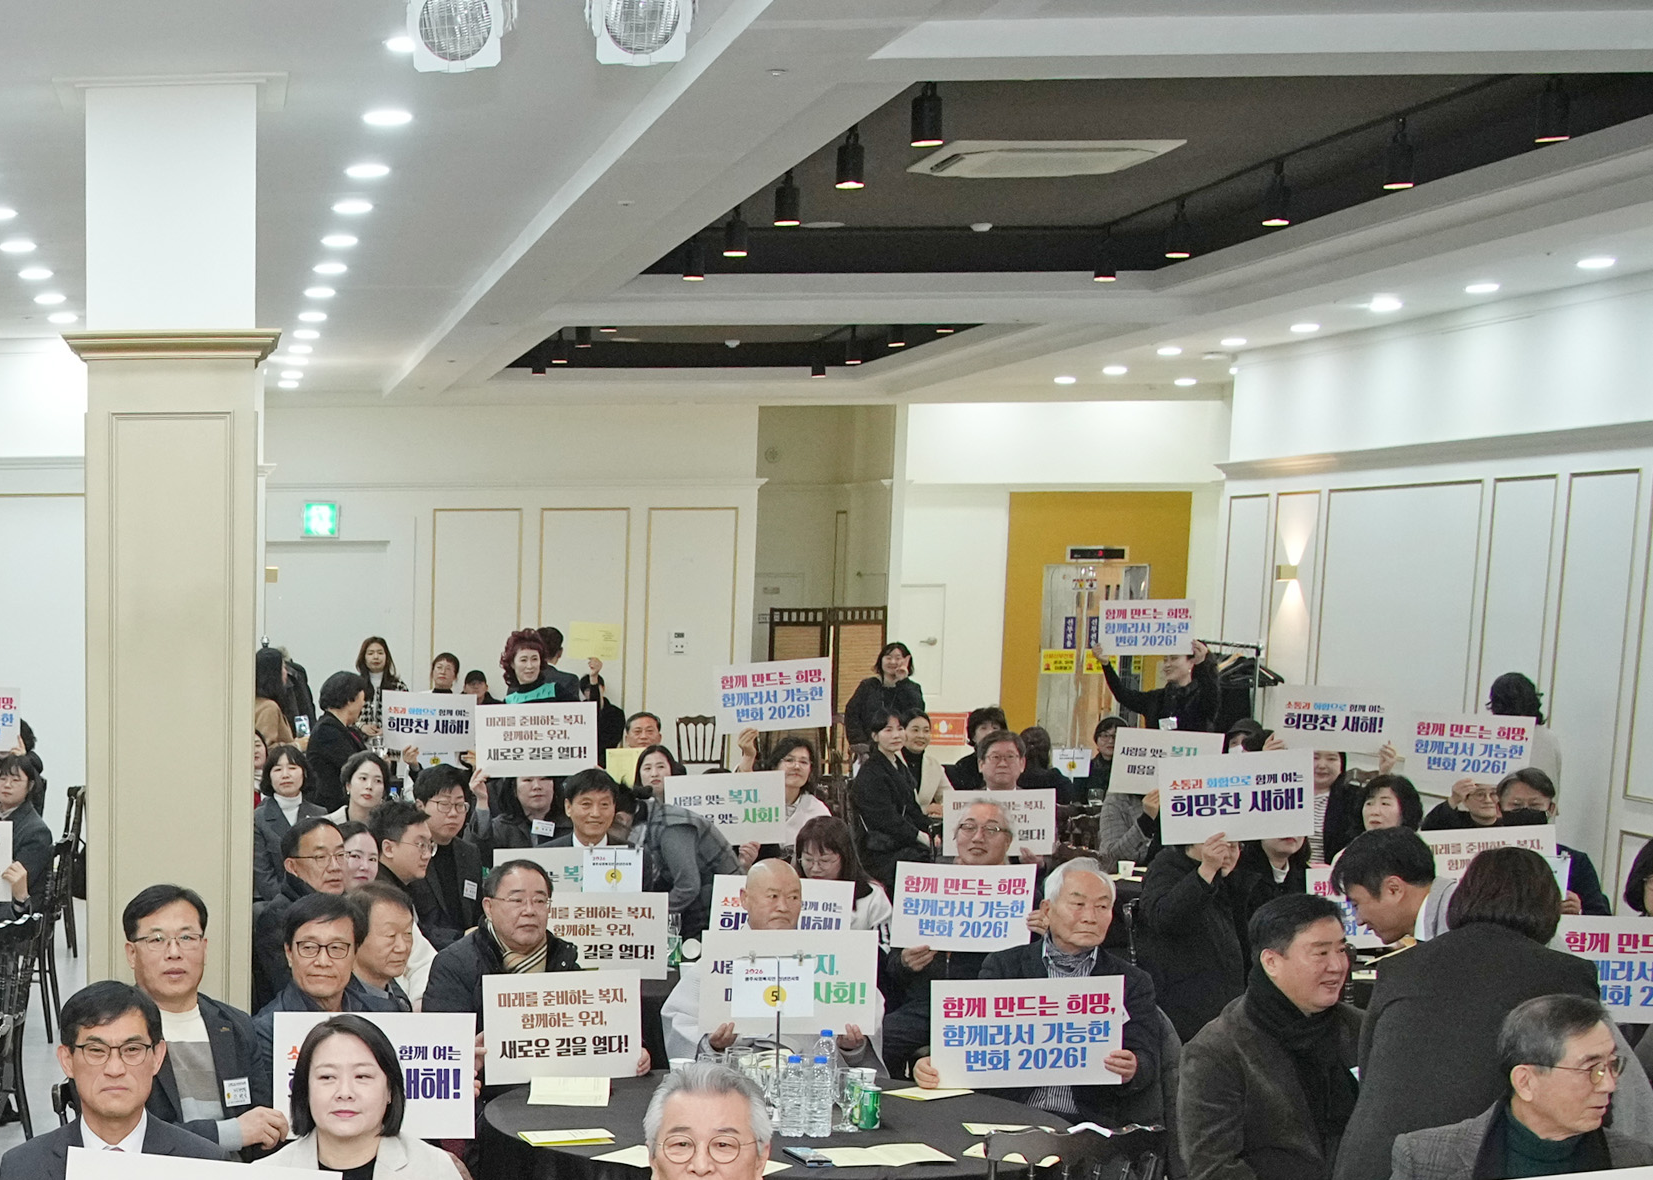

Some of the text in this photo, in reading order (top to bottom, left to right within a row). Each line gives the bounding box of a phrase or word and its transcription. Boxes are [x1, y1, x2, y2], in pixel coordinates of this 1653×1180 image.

[1116, 635, 1176, 646] 변화 2026!
[721, 669, 826, 689] 함께 만드는 희망,
[722, 687, 823, 708] 함께라서 가능한
[736, 704, 810, 722] 변화 2026!
[1283, 712, 1384, 733] 희망찬 새해!
[388, 717, 469, 735] 희망찬 새해!
[1417, 722, 1528, 742] 함께 만드는 희망,
[487, 746, 587, 761] 새로운 길을 열다!
[1428, 757, 1506, 774] 변화 2026!
[1170, 772, 1303, 790] 소통과 화합으로 함께 여는
[1171, 788, 1303, 818] 희망찬 새해!
[905, 876, 1029, 895] 함께 만드는 희망,
[903, 898, 1025, 918] 함께라서 가능한
[554, 924, 634, 937] 함께하는 우리,
[919, 919, 1008, 938] 변화 2026!
[584, 944, 654, 960] 길을 열다!
[498, 988, 627, 1008] 미래를 준비하는 복지,
[943, 993, 1115, 1018] 함께 만드는 희망,
[521, 1011, 607, 1029] 함께하는 우리,
[943, 1021, 1111, 1047] 함께라서 가능한
[399, 1046, 461, 1061] 함께 여는
[500, 1035, 629, 1059] 새로운 길을 열다!
[965, 1047, 1087, 1071] 변화 2026!
